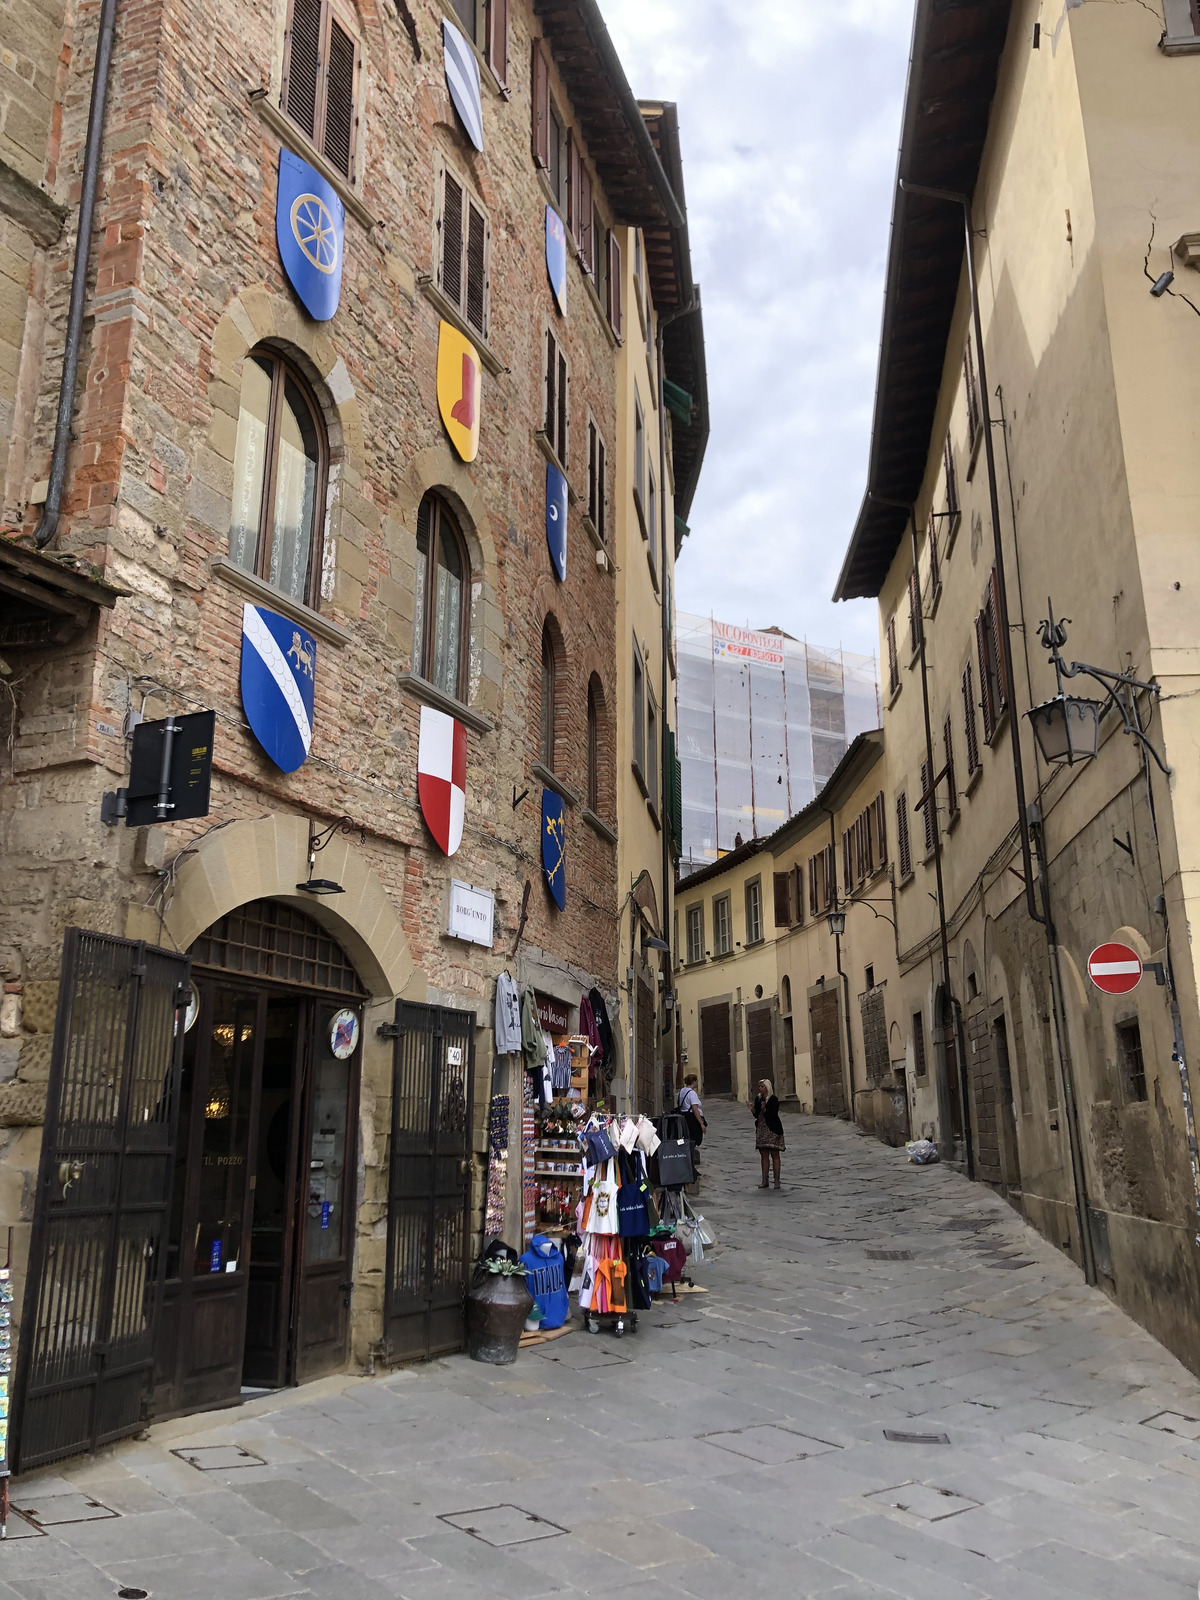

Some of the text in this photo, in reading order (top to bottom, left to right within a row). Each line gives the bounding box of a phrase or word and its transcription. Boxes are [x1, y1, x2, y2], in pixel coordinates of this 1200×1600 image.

[714, 620, 783, 651] NICO PONTEGGI
[730, 644, 742, 654] 327
[217, 1156, 243, 1166] POZZO
